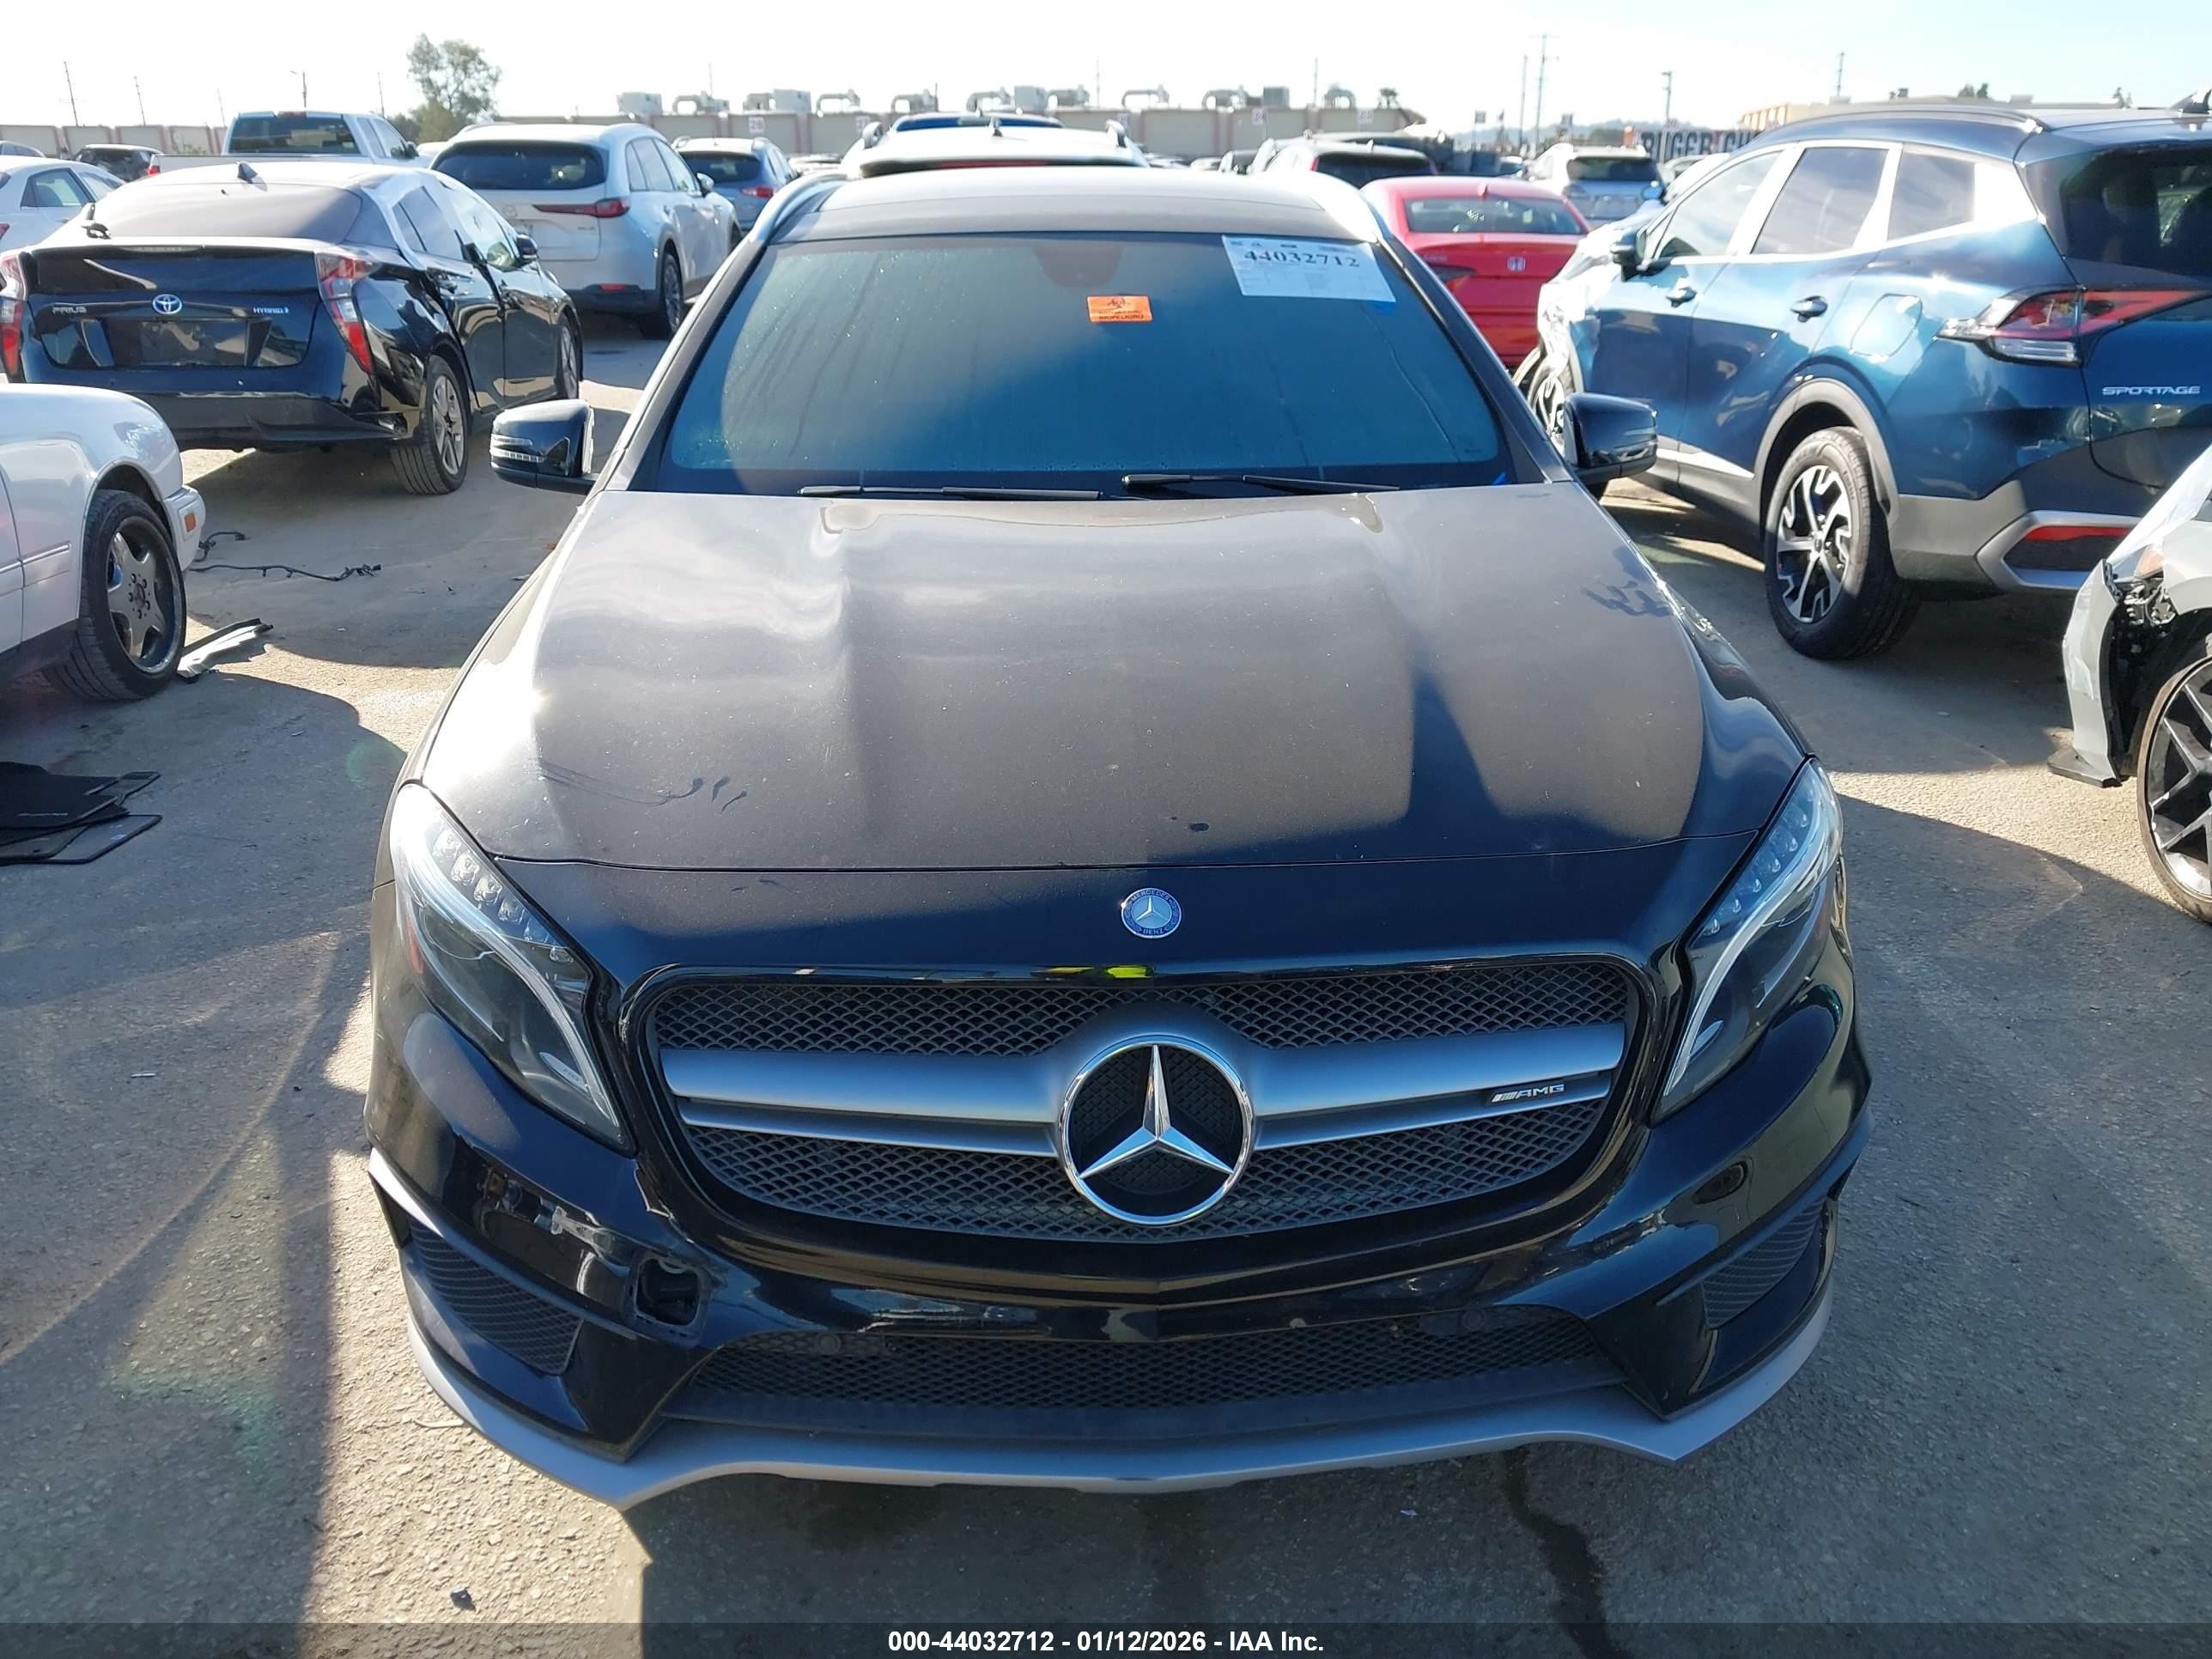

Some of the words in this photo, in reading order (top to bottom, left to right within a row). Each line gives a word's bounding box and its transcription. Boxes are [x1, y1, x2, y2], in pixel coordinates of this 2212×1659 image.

[1245, 250, 1359, 268] 44032712
[2102, 386, 2201, 395] SPORTAGE
[1132, 890, 1170, 901] MERCEDES
